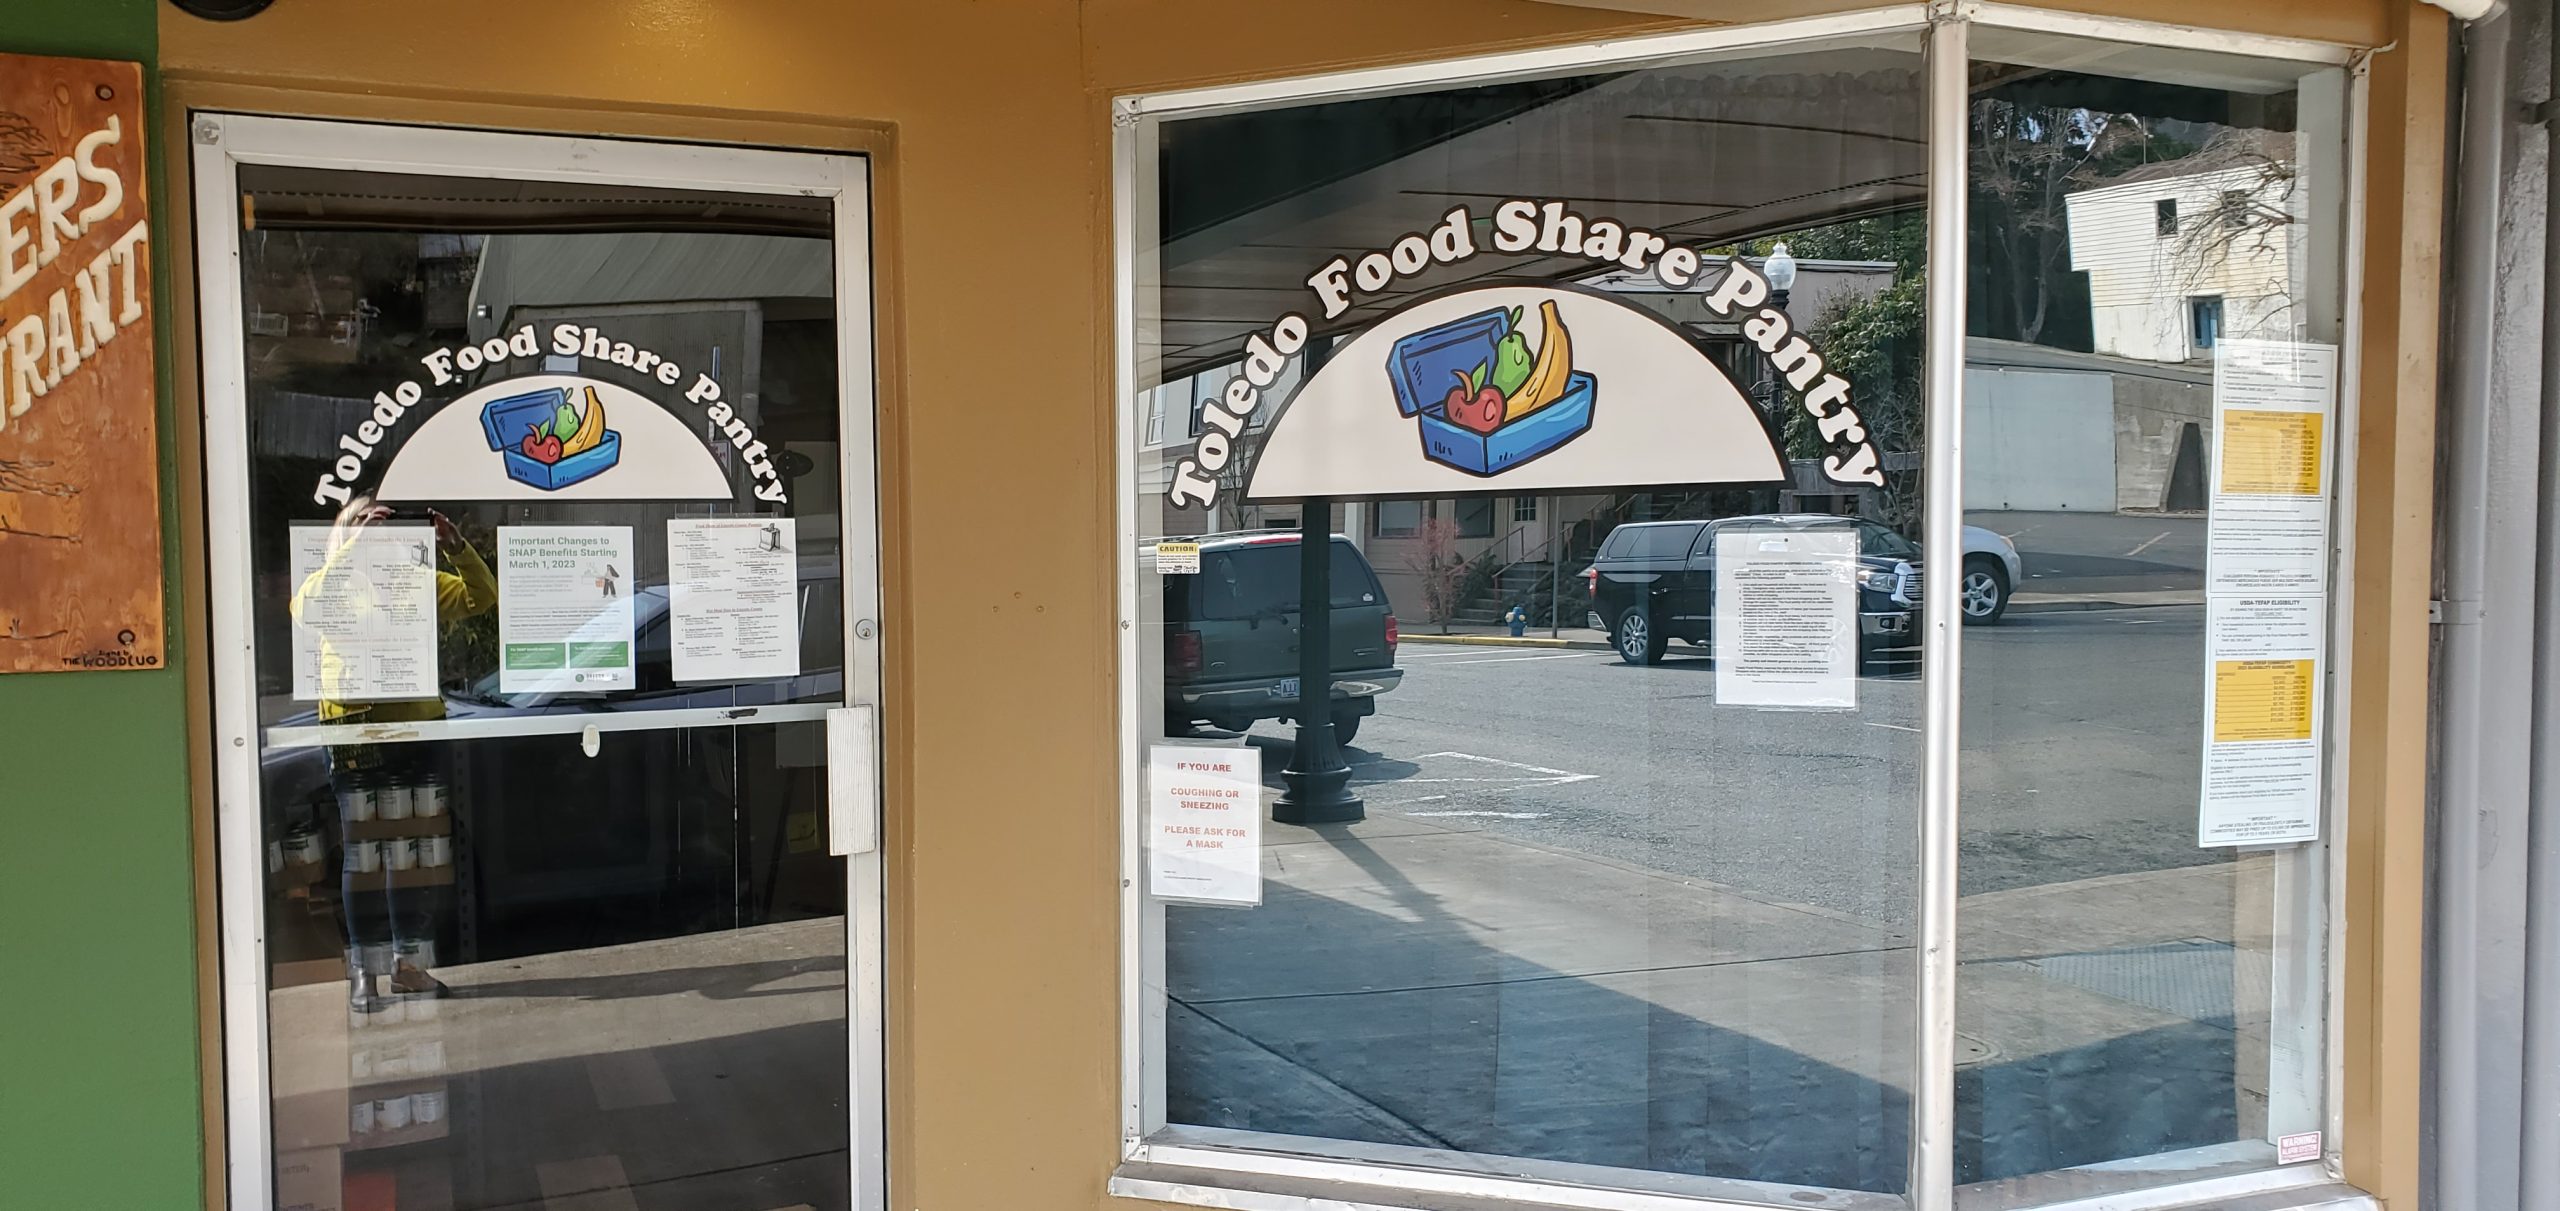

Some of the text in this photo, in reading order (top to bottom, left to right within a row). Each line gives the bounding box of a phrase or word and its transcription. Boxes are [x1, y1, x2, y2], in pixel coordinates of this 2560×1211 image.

[1171, 200, 1884, 506] Toledo Food Share Pantry
[314, 324, 787, 507] Toledo Food Share Pantry
[509, 536, 609, 546] Important Changes to
[509, 548, 617, 558] SNAP Benefits Starting
[509, 560, 576, 570] March 1, 2023
[1189, 763, 1209, 771] YOU
[1212, 764, 1231, 772] ARE
[1171, 788, 1239, 798] COUGHING OR
[1181, 801, 1229, 810] SNEEZING
[1165, 826, 1246, 837] PLEASE ASK FOR
[1196, 840, 1223, 848] MASK
